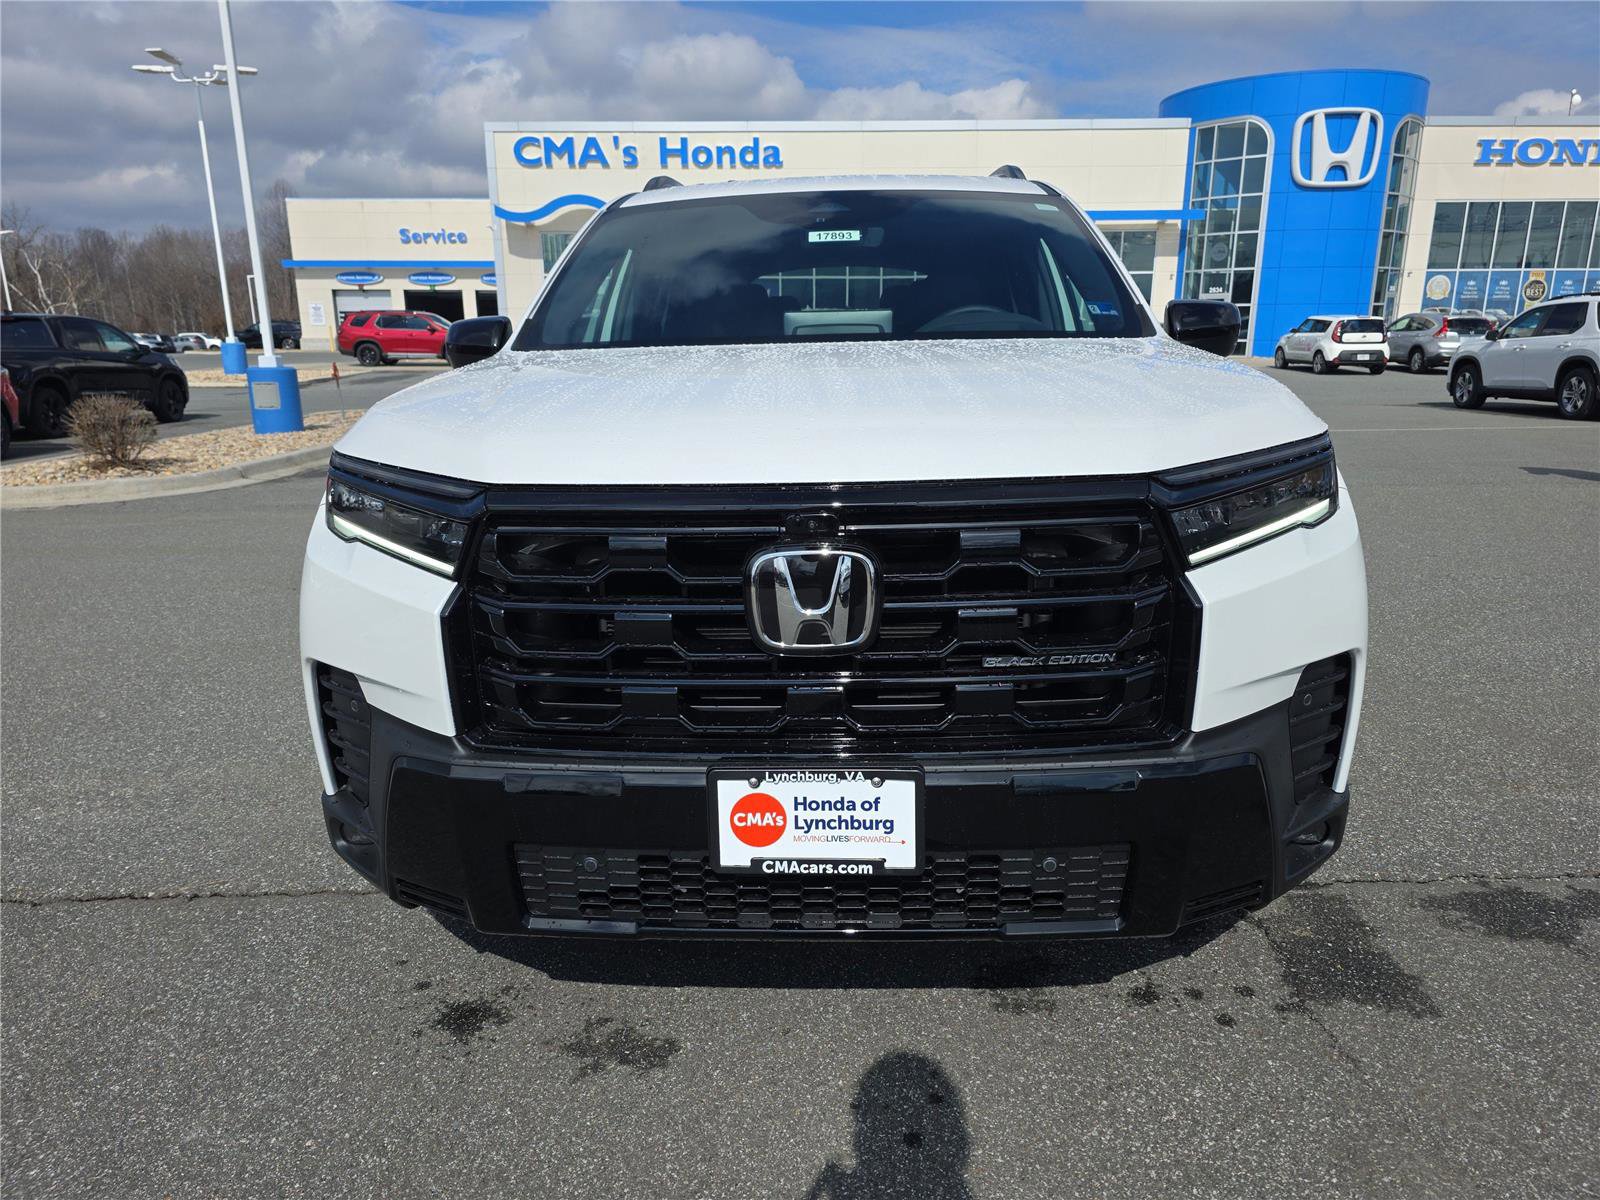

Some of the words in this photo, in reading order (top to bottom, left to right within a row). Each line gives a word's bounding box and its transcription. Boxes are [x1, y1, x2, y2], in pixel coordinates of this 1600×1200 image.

[513, 135, 638, 168] CMA's
[659, 135, 783, 168] Honda
[399, 228, 468, 245] Service
[816, 232, 853, 240] 17893
[1525, 288, 1543, 296] BEST
[983, 655, 1046, 668] BLACK
[1048, 653, 1116, 665] EDITION
[765, 771, 841, 784] Lynchburg,
[845, 771, 865, 782] VA
[793, 796, 857, 812] Honda
[860, 796, 881, 812] of
[733, 812, 784, 827] CMA's
[794, 815, 894, 834] Lynchburg
[762, 860, 873, 875] CMAcars.com
